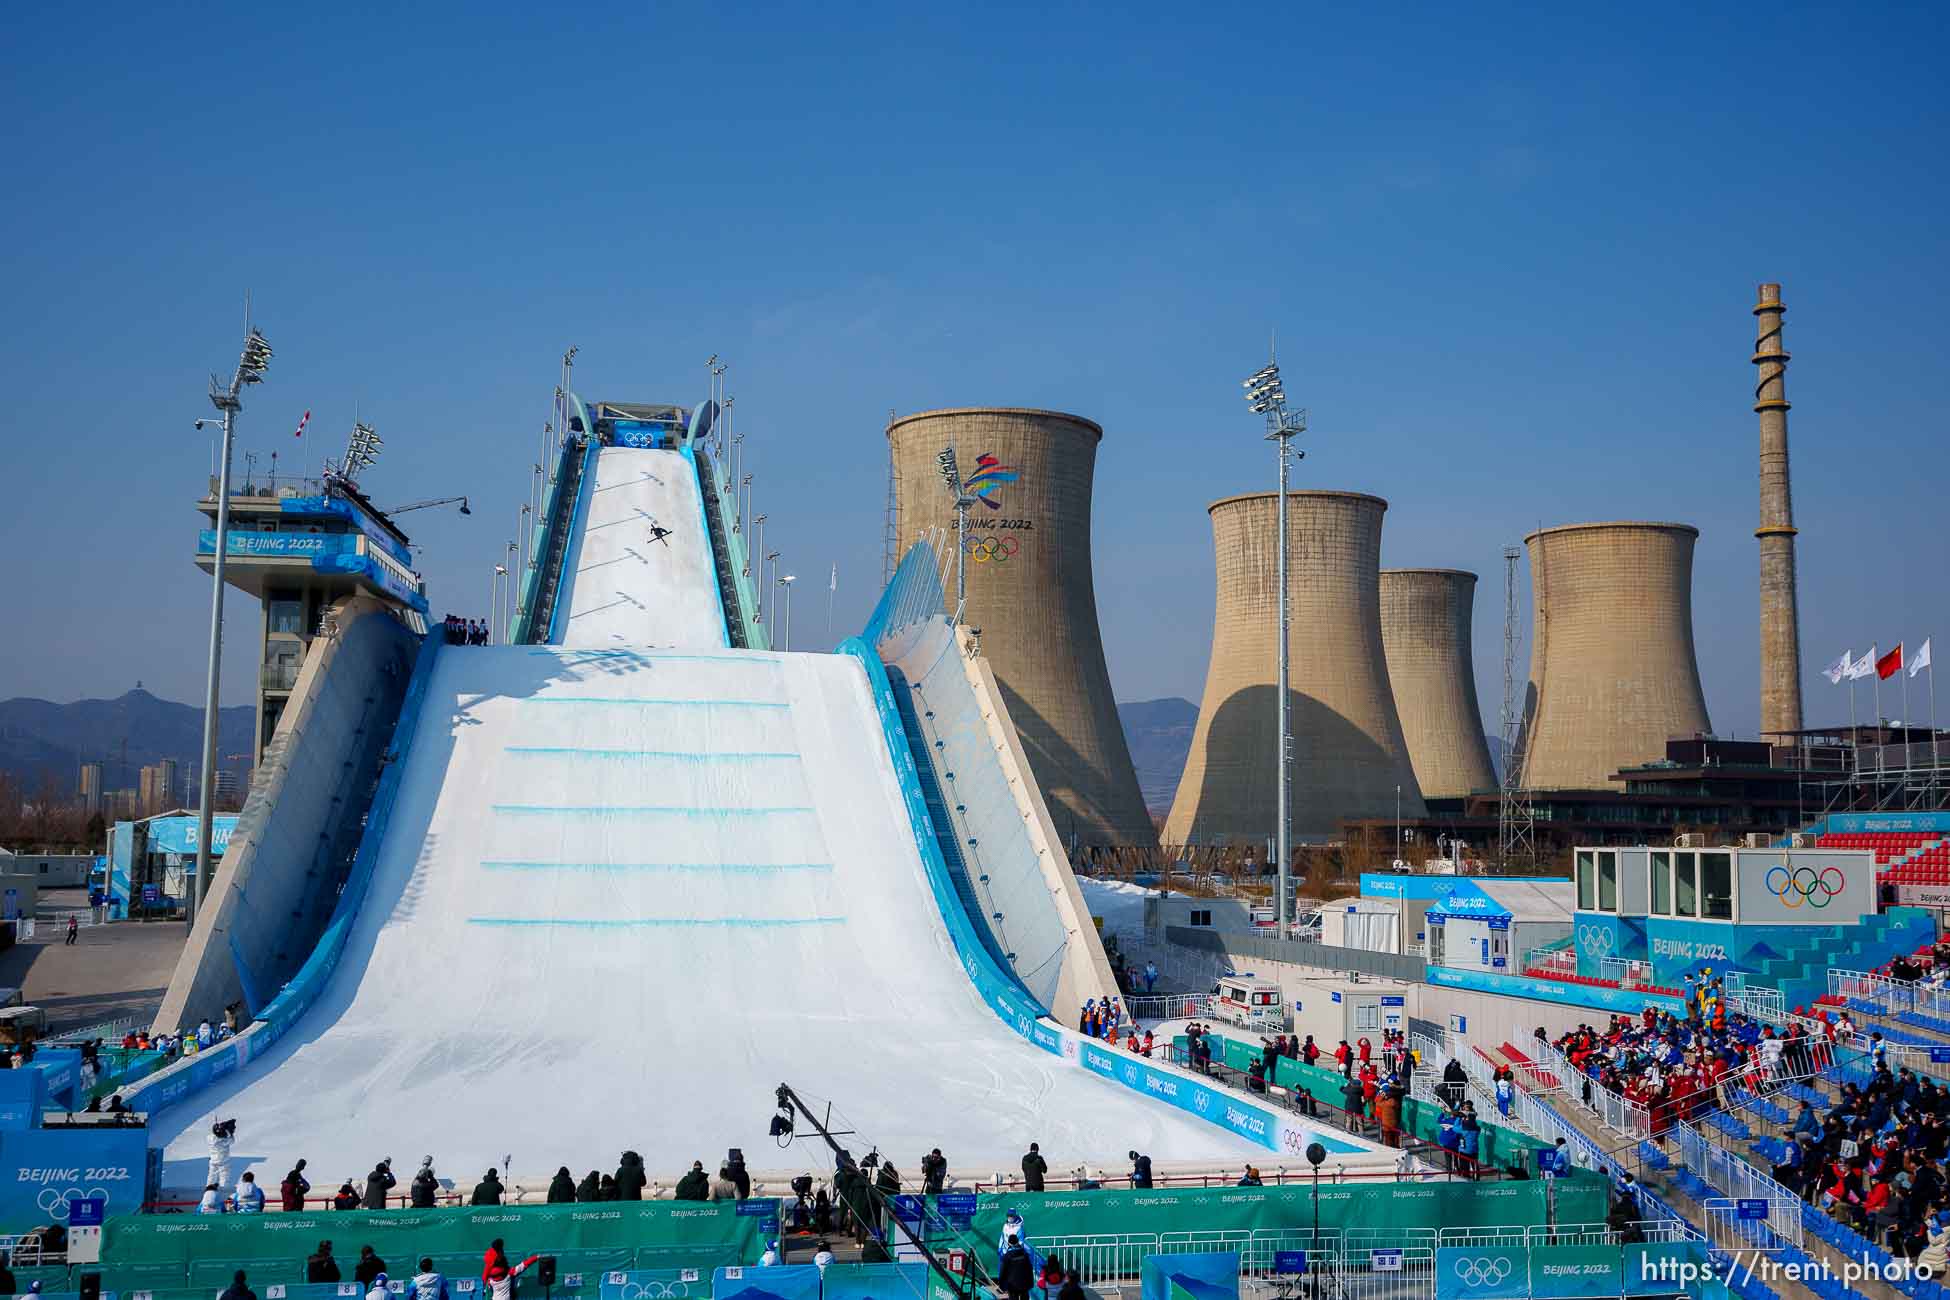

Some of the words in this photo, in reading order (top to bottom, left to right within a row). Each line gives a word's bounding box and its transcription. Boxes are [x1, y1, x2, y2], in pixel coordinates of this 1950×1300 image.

[952, 519, 996, 532] BIJING
[1000, 519, 1034, 530] 2022
[236, 537, 285, 551] BEIJING
[289, 538, 324, 550] 2022
[1449, 896, 1469, 910] BEIJING
[1653, 938, 1692, 960] BEIJING
[1695, 944, 1728, 960] 2022
[1146, 1074, 1163, 1092] BEIJING
[1163, 1082, 1178, 1096] 2022
[1226, 1106, 1248, 1127] BEIJING
[1248, 1116, 1265, 1135] 2022
[17, 1168, 79, 1185] BEIJING
[84, 1168, 130, 1180] 2022
[1222, 1195, 1247, 1203] BEIJING
[1392, 1190, 1417, 1198] BEIJING
[1045, 1200, 1070, 1209] BEIJING
[1071, 1200, 1090, 1208] 2022
[1134, 1197, 1159, 1206] BEIJING
[572, 1212, 599, 1221] BEIJING
[601, 1211, 622, 1219] 2022
[671, 1209, 698, 1219] BEIJING
[699, 1209, 720, 1217] 2022
[471, 1215, 500, 1225] BEIJING
[501, 1214, 521, 1222] 2022
[156, 1224, 186, 1233] BEIJING
[188, 1223, 210, 1231] 2022
[263, 1221, 292, 1230] BEIJING
[295, 1220, 317, 1228] 2022
[685, 1270, 694, 1279] 14
[730, 1268, 739, 1277] 15
[1543, 1264, 1581, 1277] BEIJING
[1584, 1264, 1612, 1274] 2022
[344, 1284, 350, 1293] 8
[392, 1283, 399, 1292] 9
[461, 1282, 471, 1290] 10
[273, 1287, 280, 1297] 7
